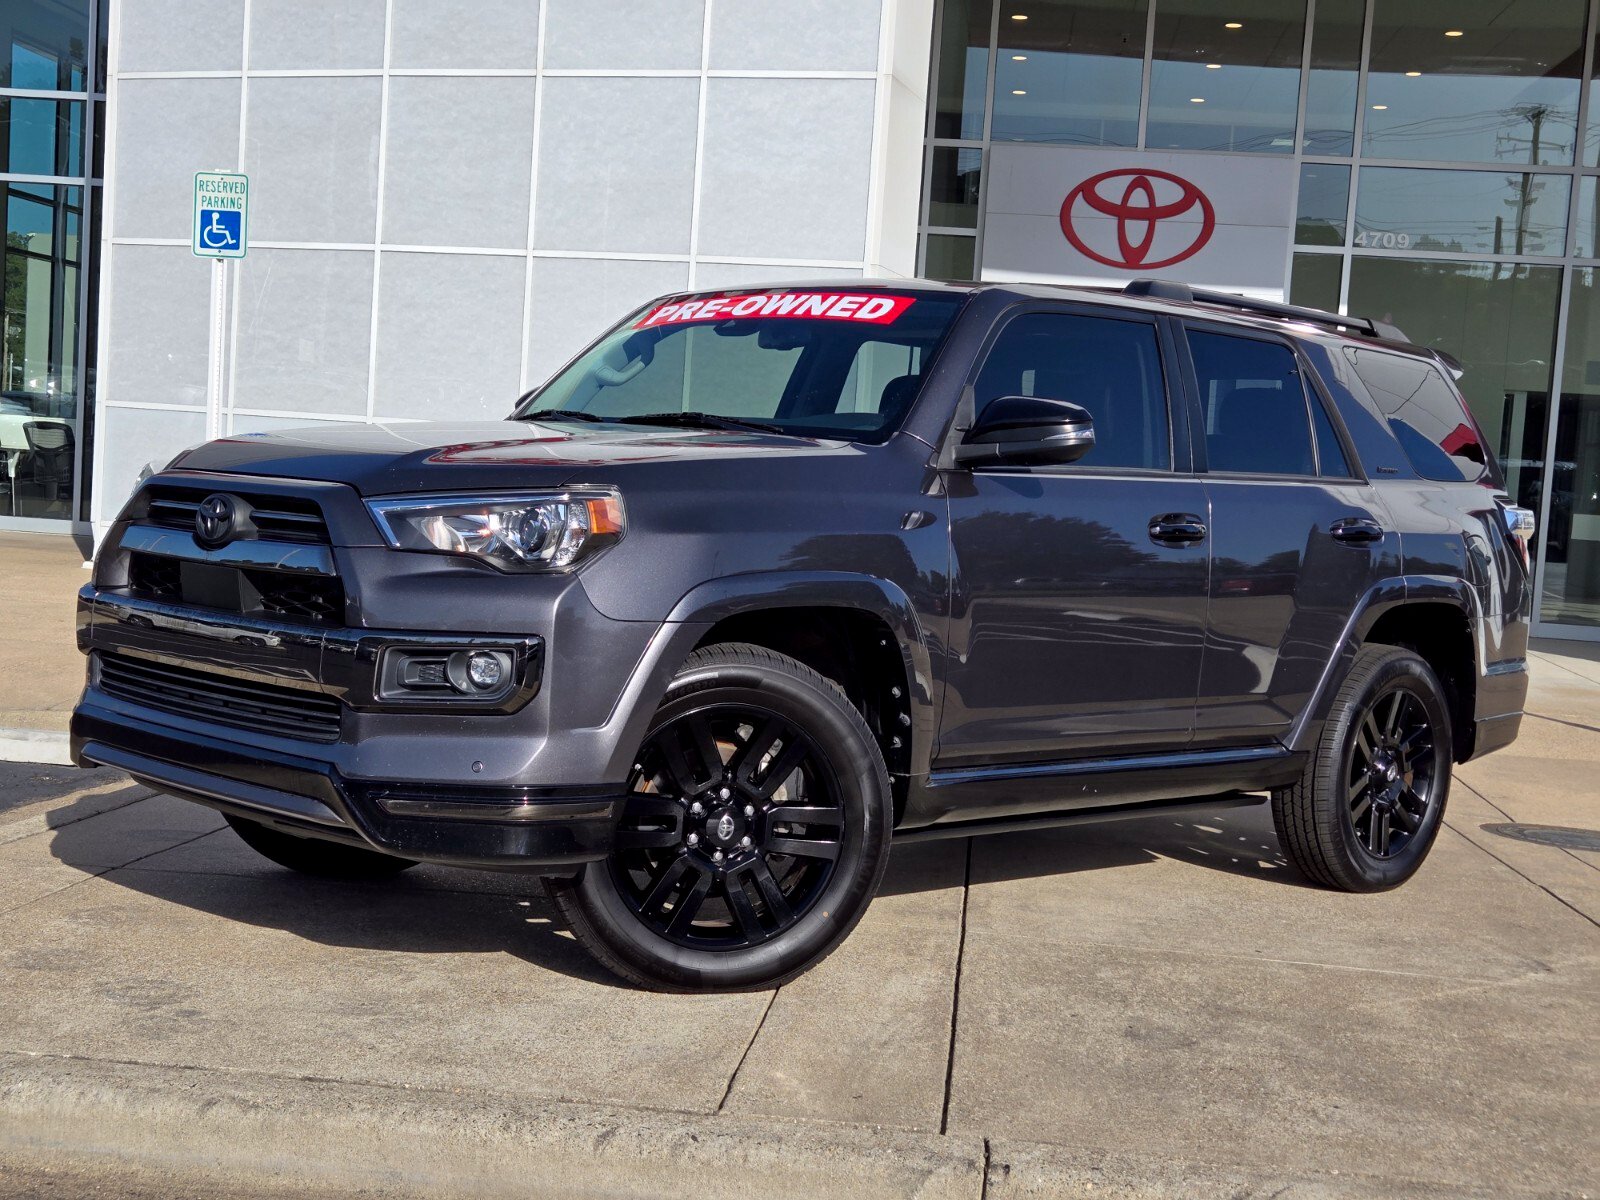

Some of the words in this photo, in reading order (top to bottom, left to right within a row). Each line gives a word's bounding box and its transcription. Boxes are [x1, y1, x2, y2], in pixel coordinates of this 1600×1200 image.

[199, 180, 245, 194] RESERVED
[201, 195, 242, 210] PARKING
[1354, 231, 1410, 249] 4709
[644, 294, 896, 326] PRE-OWNED
